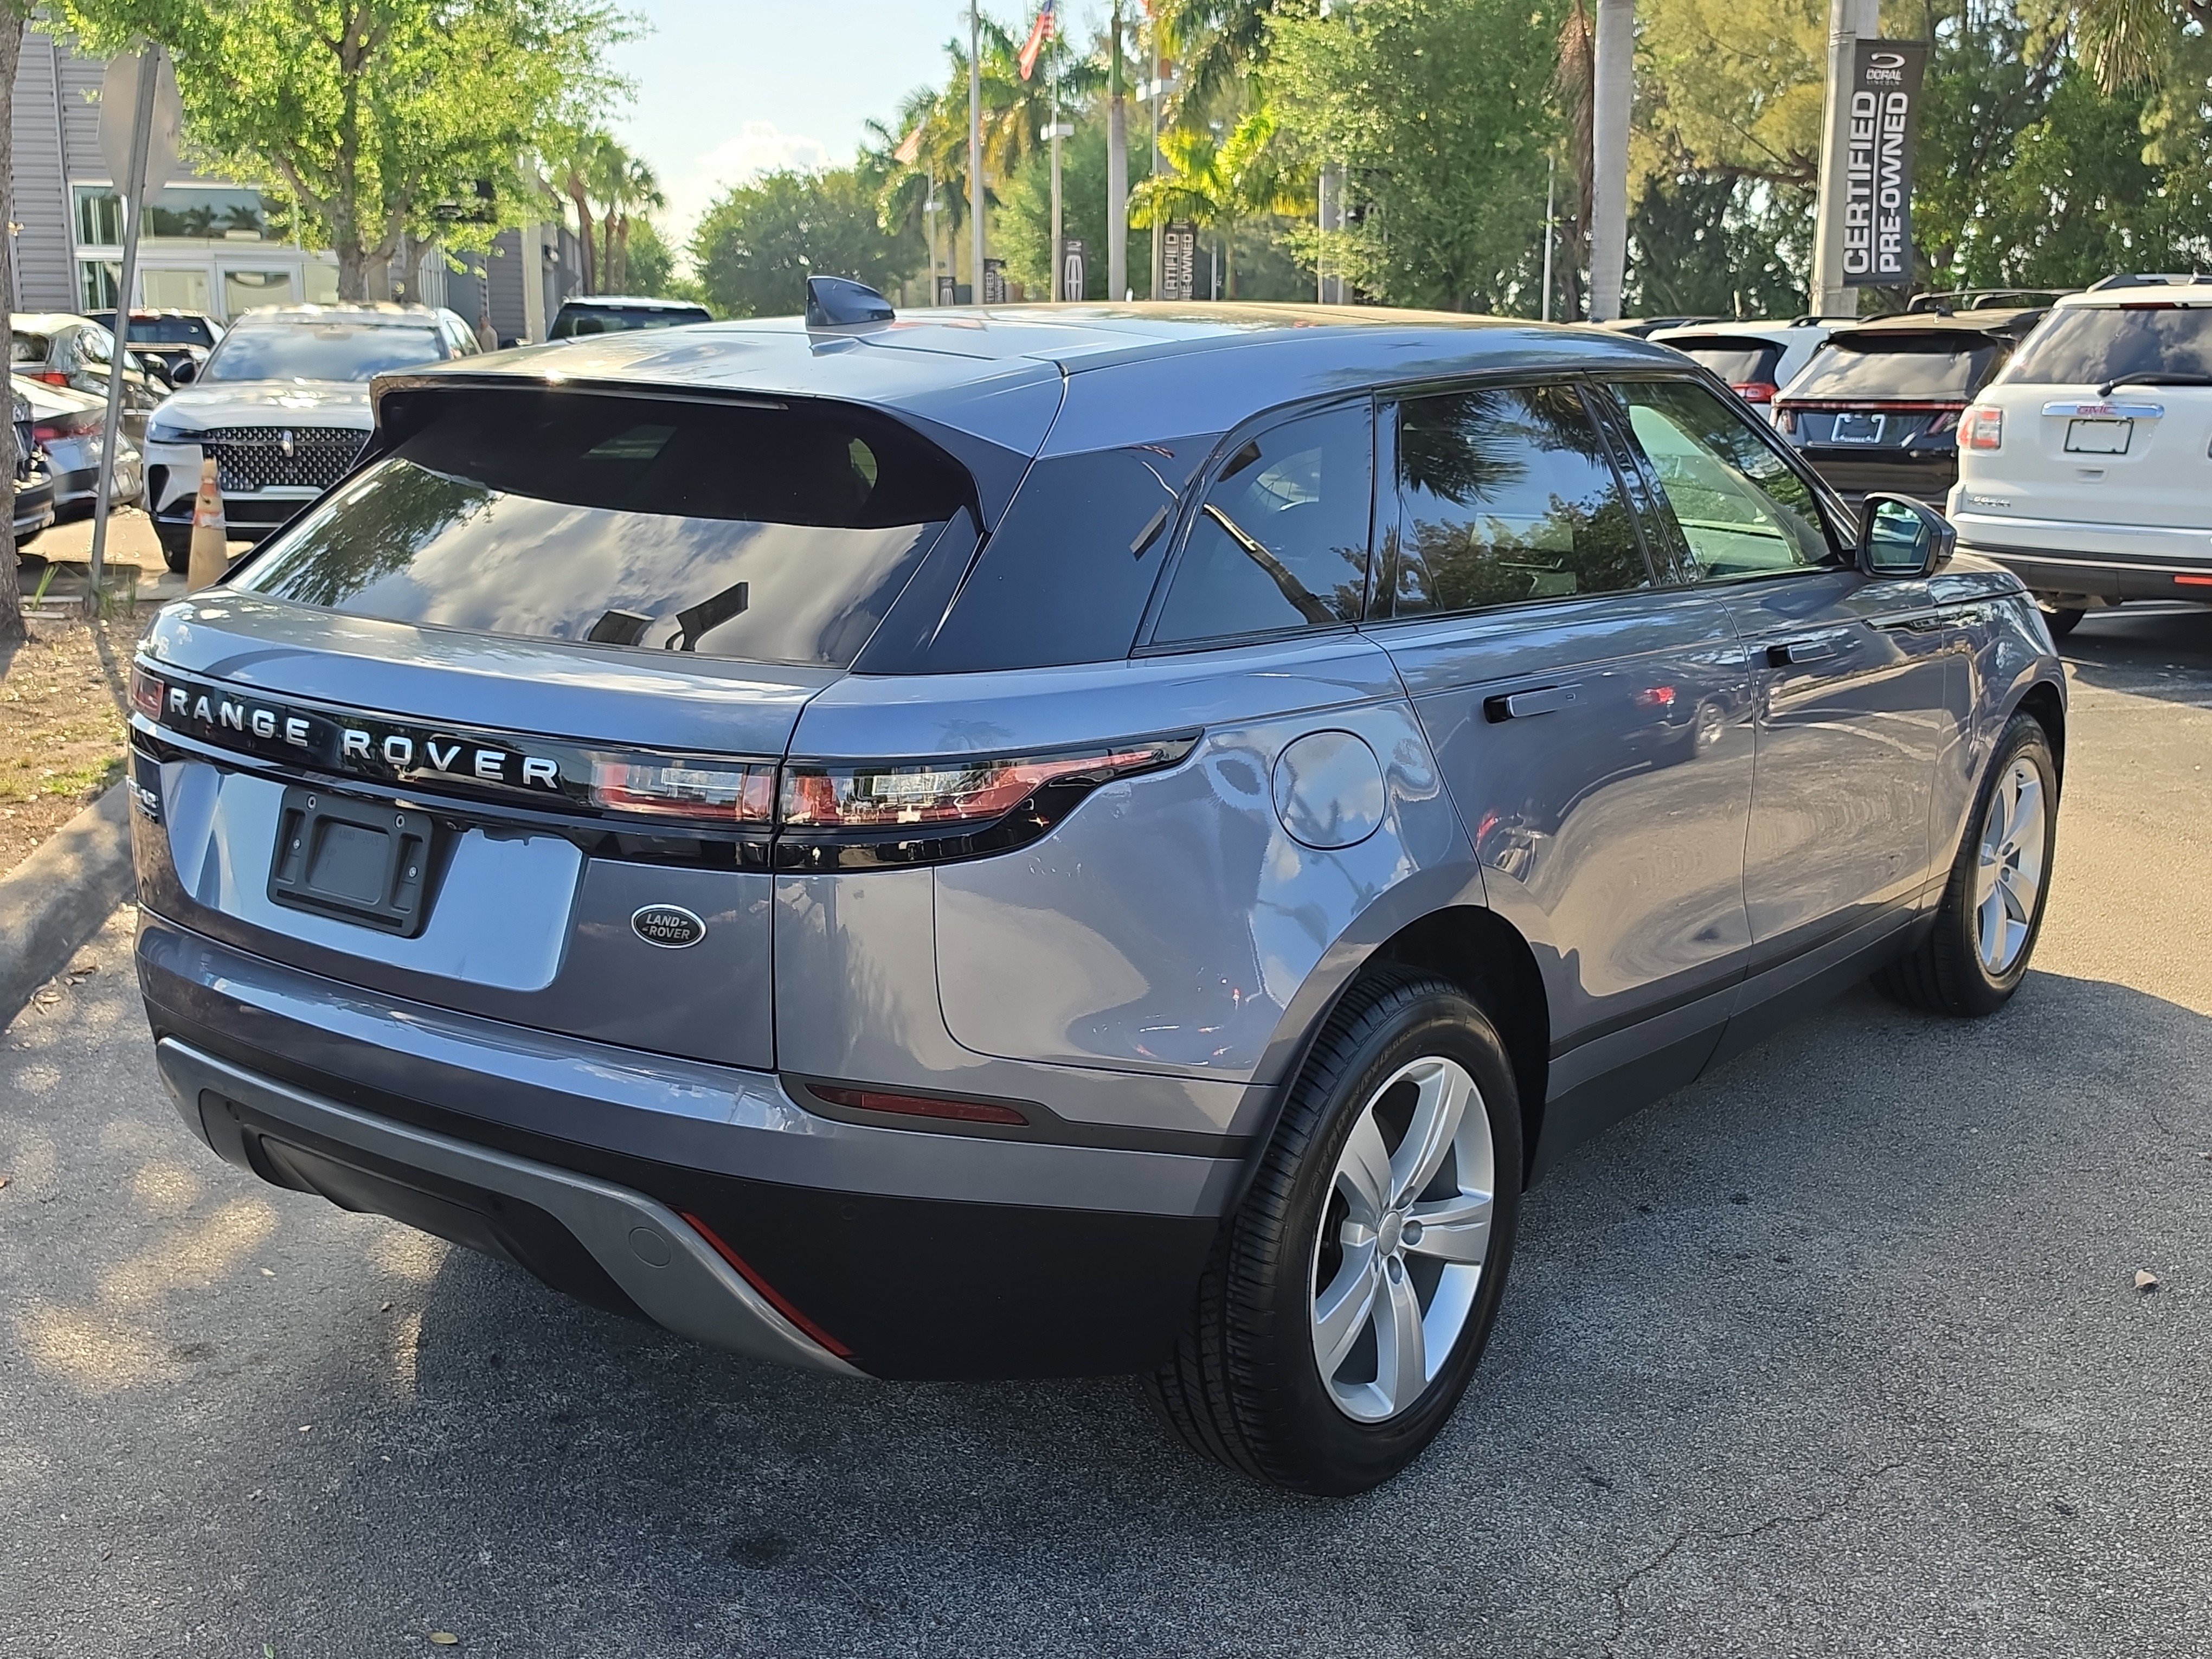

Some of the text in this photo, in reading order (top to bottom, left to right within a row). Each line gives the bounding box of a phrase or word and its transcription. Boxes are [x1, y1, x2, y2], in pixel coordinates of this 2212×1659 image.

[1843, 91, 1876, 274] CERTIFIED
[1879, 92, 1908, 273] PRE-OWNED
[170, 687, 558, 789] RANGE ROVER
[646, 913, 680, 927] LAND
[649, 925, 690, 940] ROVER
